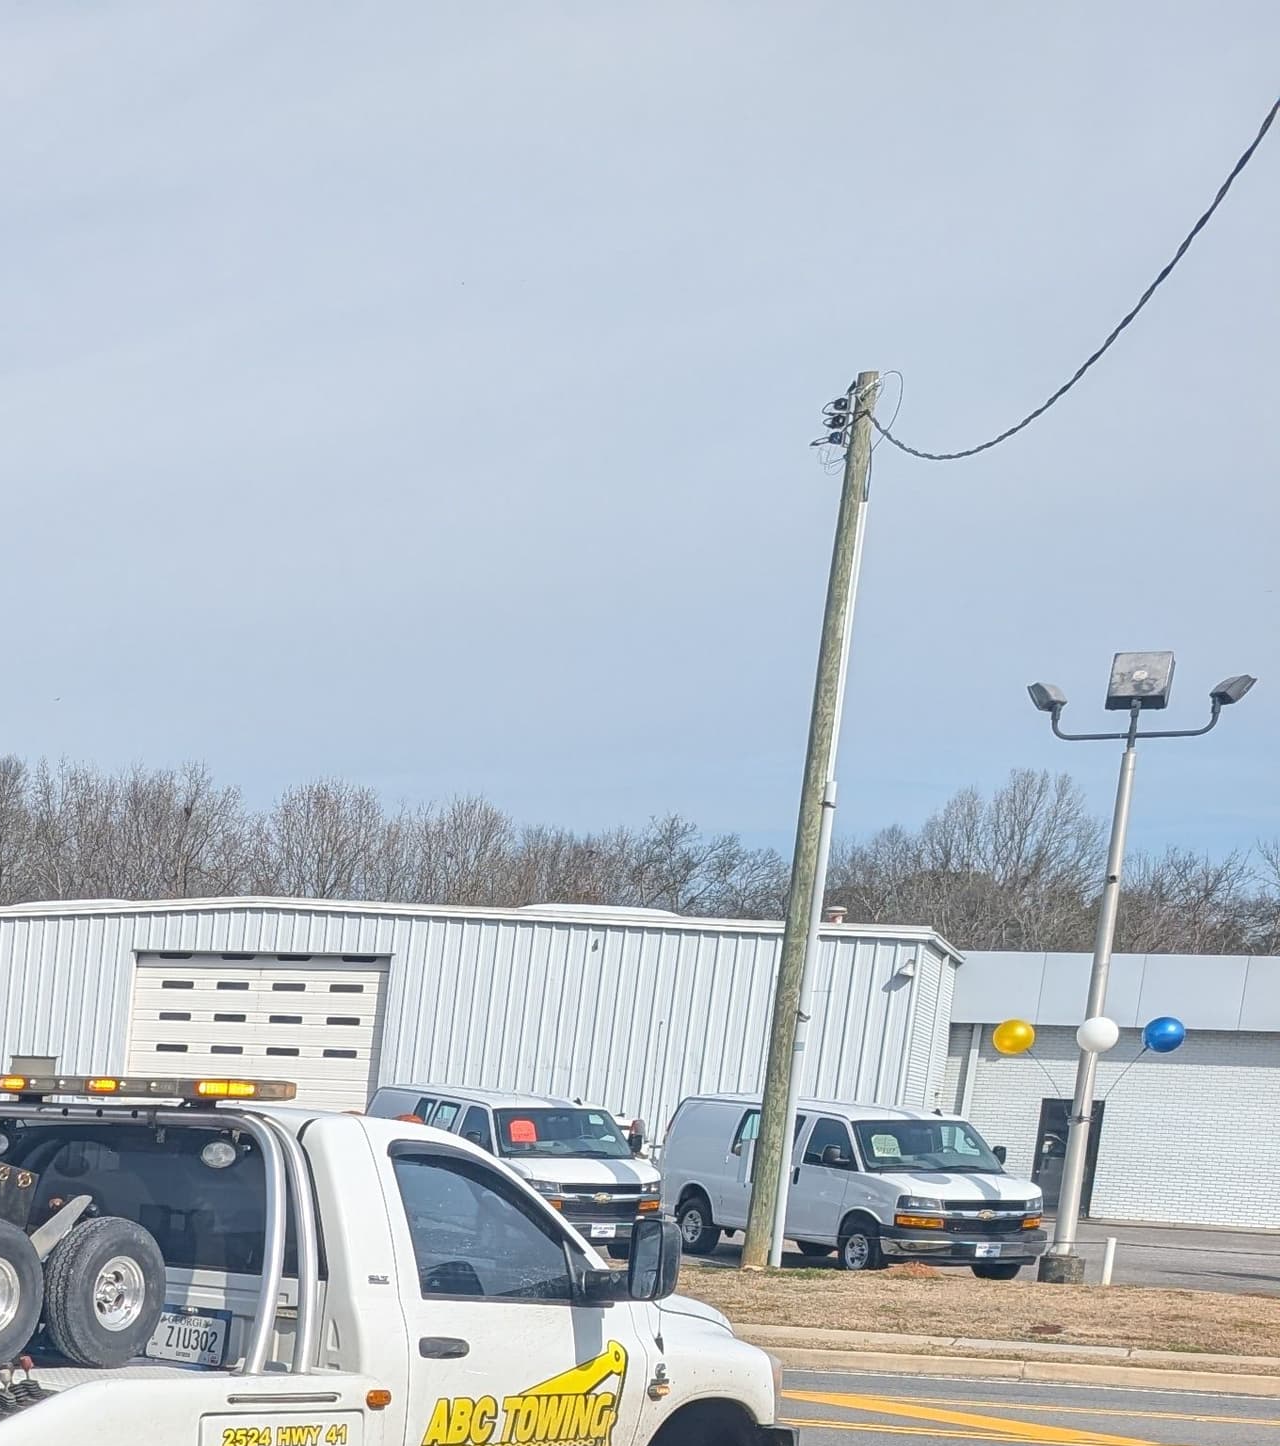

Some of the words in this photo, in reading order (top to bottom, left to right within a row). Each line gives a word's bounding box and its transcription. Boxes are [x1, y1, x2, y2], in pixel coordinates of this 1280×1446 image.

[276, 1425, 322, 1446] HWY
[325, 1424, 348, 1445] 41
[500, 1391, 615, 1445] TOWING
